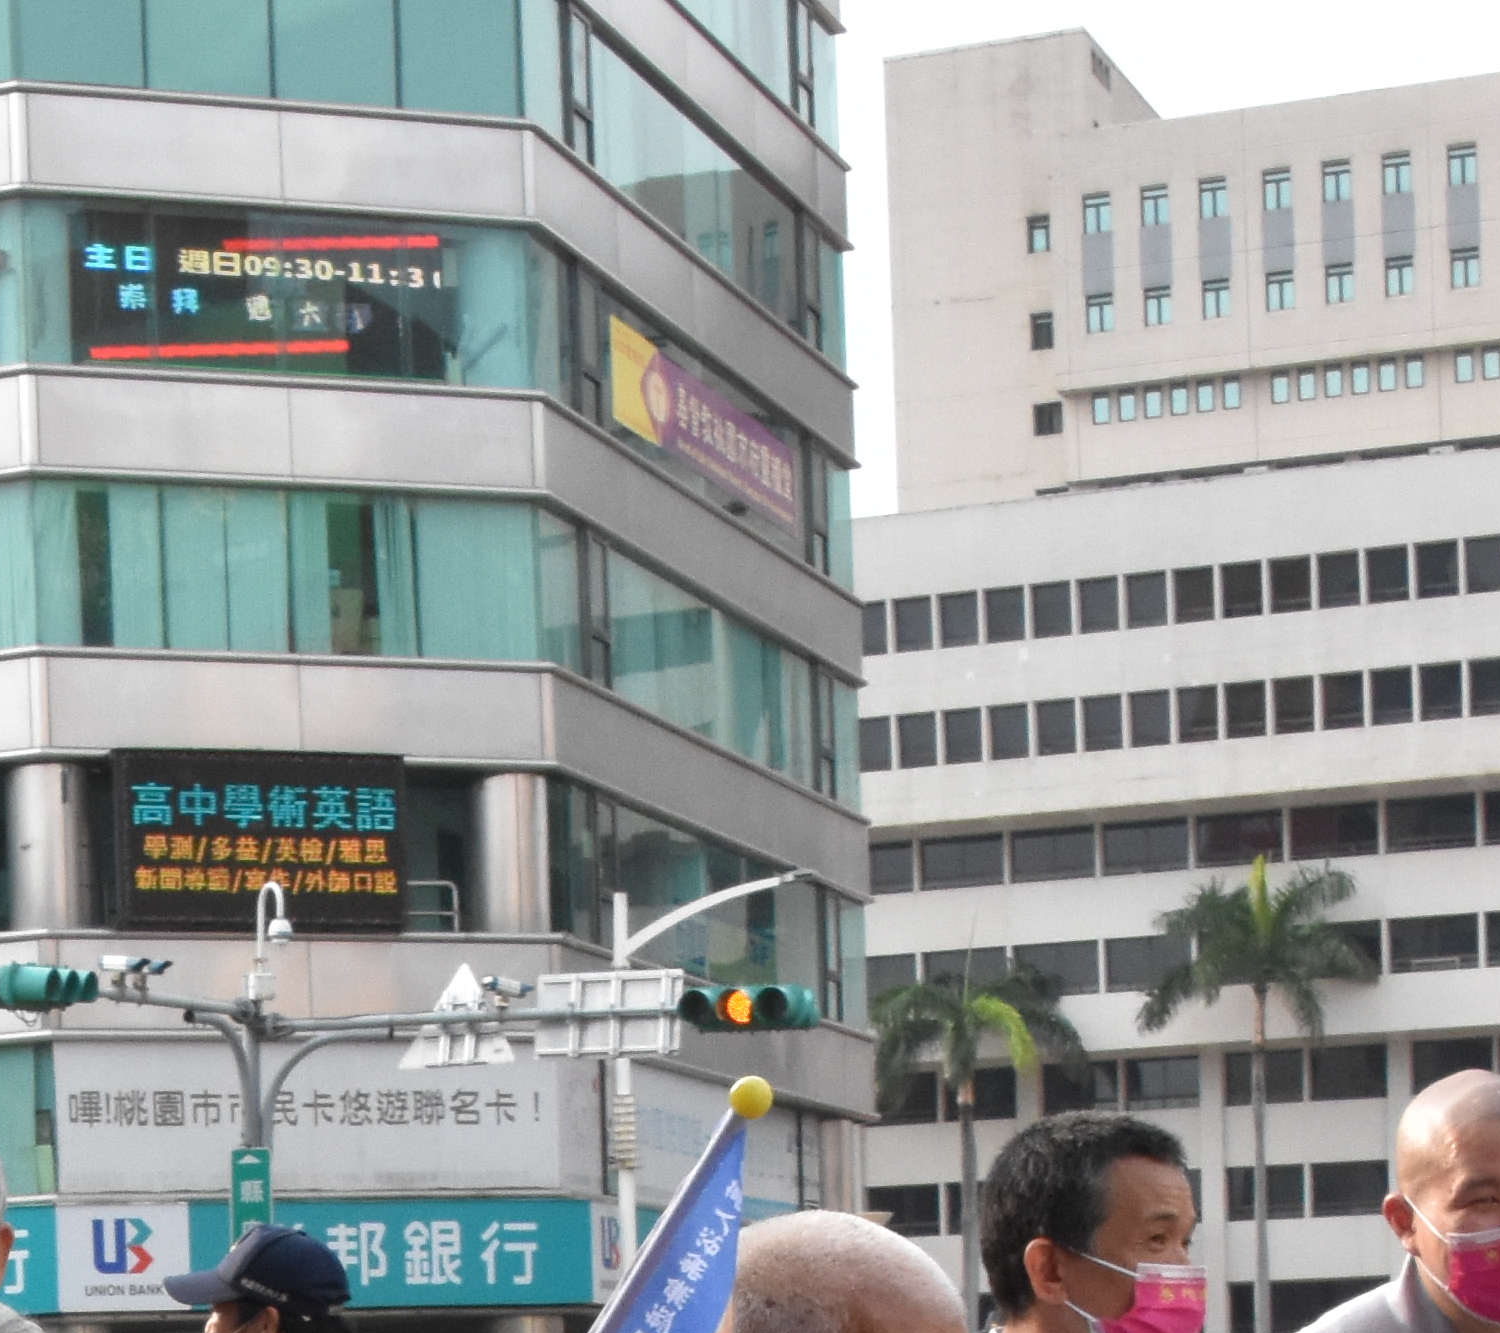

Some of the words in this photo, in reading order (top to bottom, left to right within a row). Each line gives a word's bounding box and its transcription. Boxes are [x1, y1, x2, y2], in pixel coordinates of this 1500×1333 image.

[83, 242, 152, 272] 主日
[130, 781, 397, 832] 高中學術英語
[308, 1218, 541, 1288] 邦銀行
[84, 1284, 126, 1297] UNION
[128, 1283, 165, 1296] BANK
